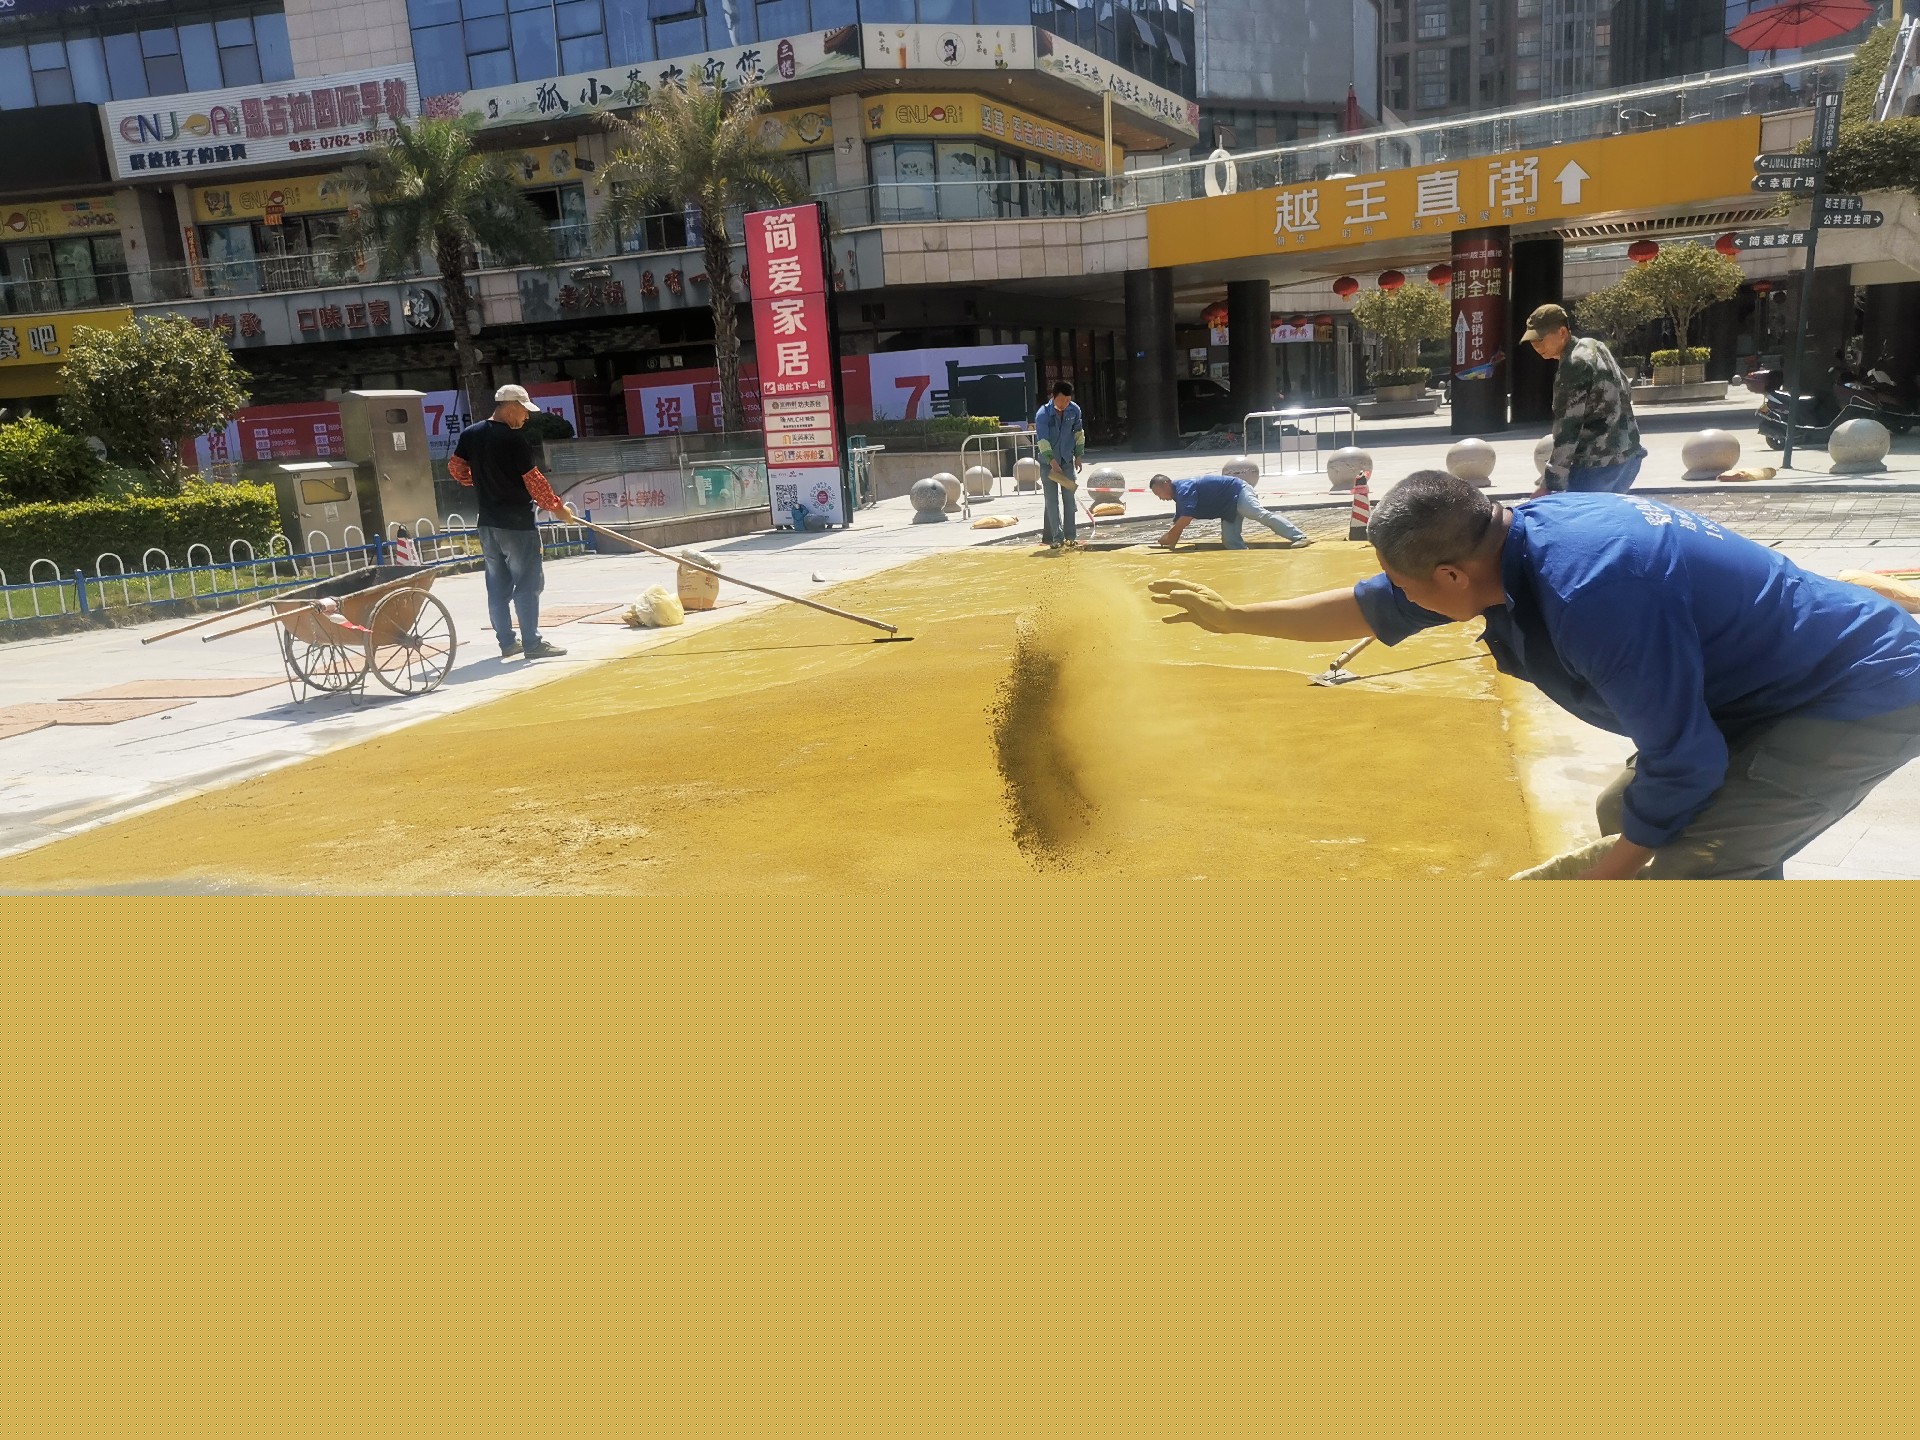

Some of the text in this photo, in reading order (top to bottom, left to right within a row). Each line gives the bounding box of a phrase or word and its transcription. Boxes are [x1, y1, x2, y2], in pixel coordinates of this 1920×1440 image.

[1769, 176, 1815, 189] 幸福广场
[1274, 156, 1539, 235] 越王直街
[1823, 214, 1872, 225] 公共卫生间
[1749, 233, 1804, 247] 简爱家居
[763, 213, 810, 378] 简爱家居
[1471, 311, 1484, 361] 营销中心
[777, 380, 826, 392] 由此下负一楼
